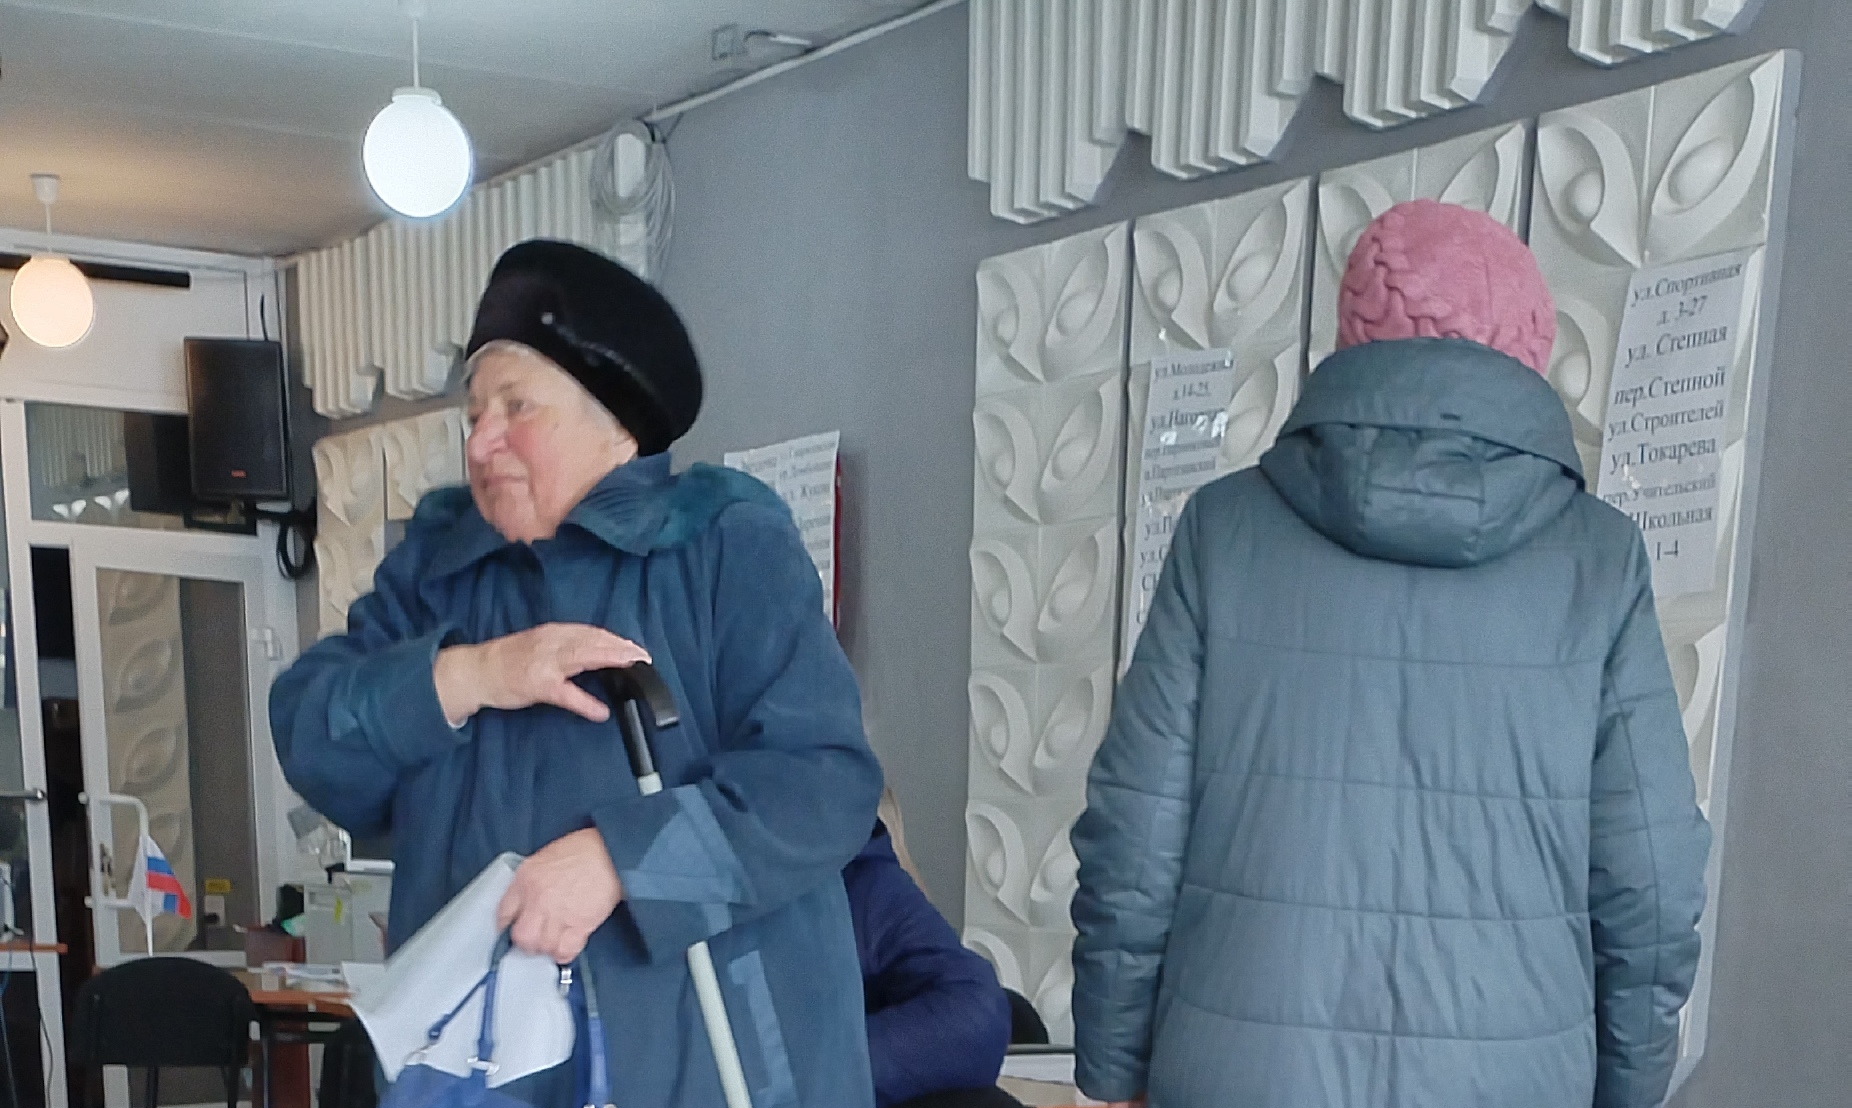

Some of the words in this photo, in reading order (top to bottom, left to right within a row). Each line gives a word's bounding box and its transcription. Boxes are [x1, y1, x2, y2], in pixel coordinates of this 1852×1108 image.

[1656, 325, 1728, 356] Степная
[1614, 366, 1726, 407] пер.Степной
[1608, 403, 1724, 441] ул.Строителей
